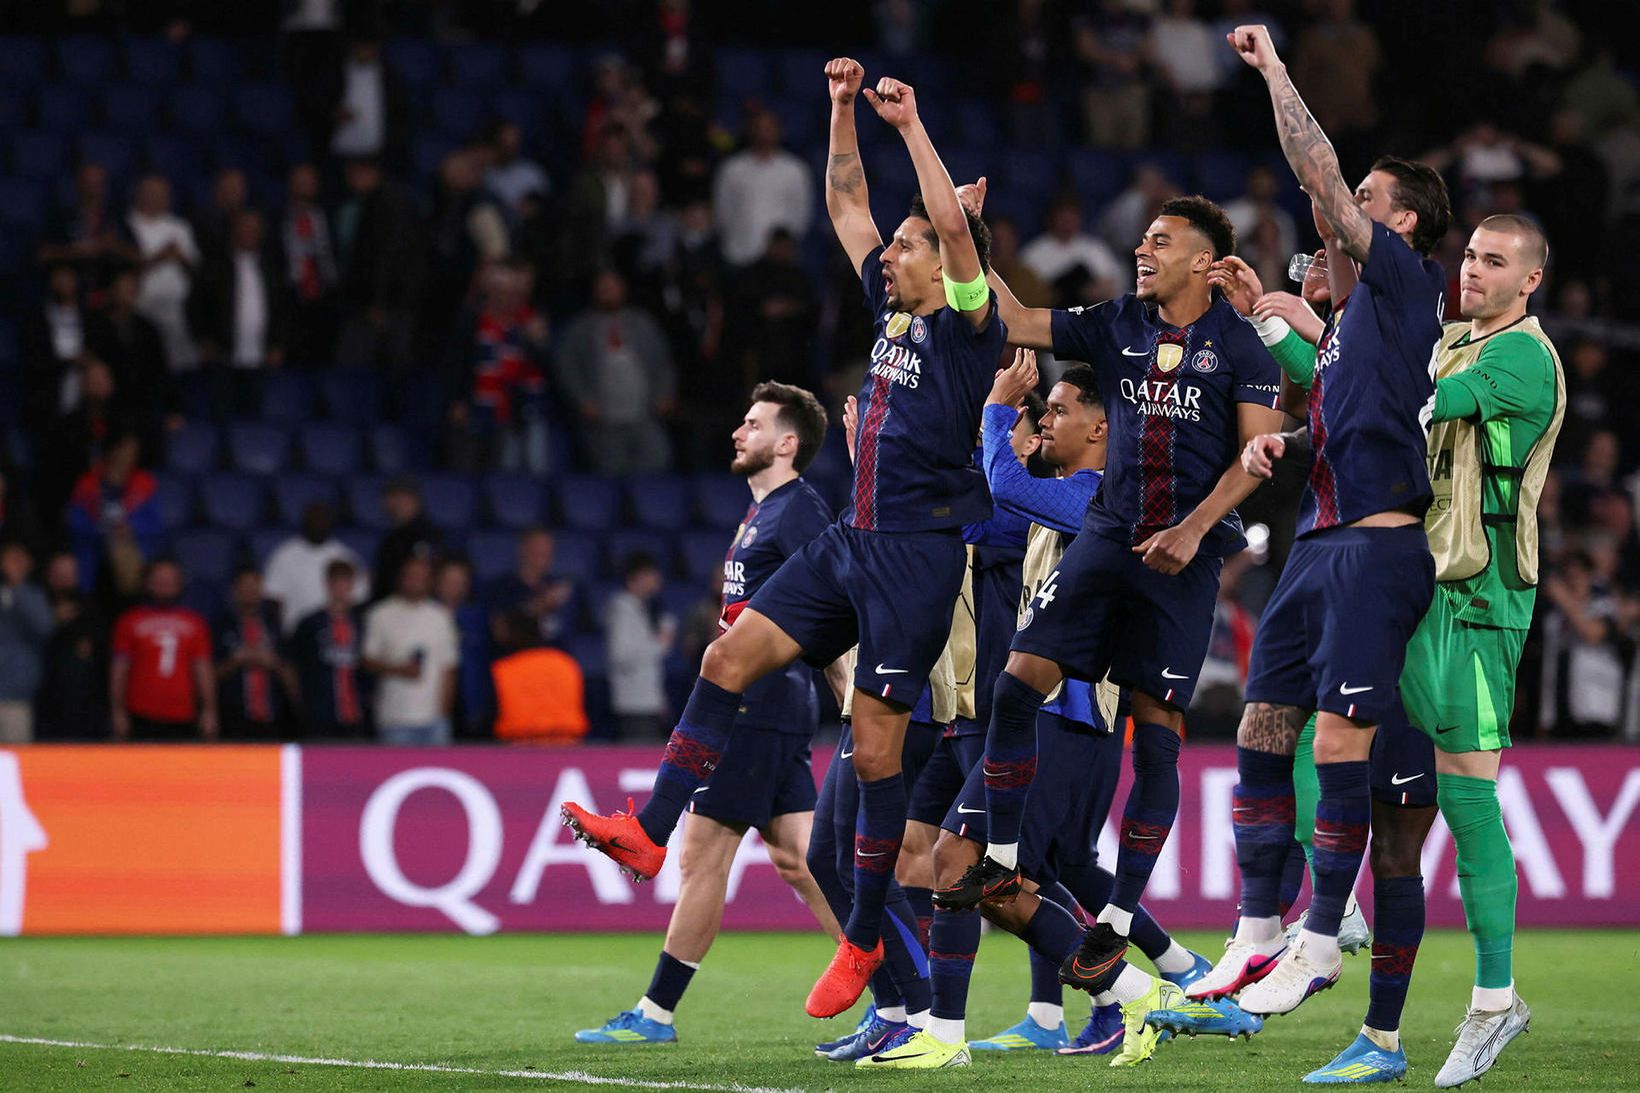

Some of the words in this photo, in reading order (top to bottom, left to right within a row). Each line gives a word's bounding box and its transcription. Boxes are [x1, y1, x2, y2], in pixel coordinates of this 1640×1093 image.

[870, 362, 919, 389] AIRWAYS
[1120, 378, 1201, 409] QATAR
[1137, 402, 1200, 422] AIRWAYS
